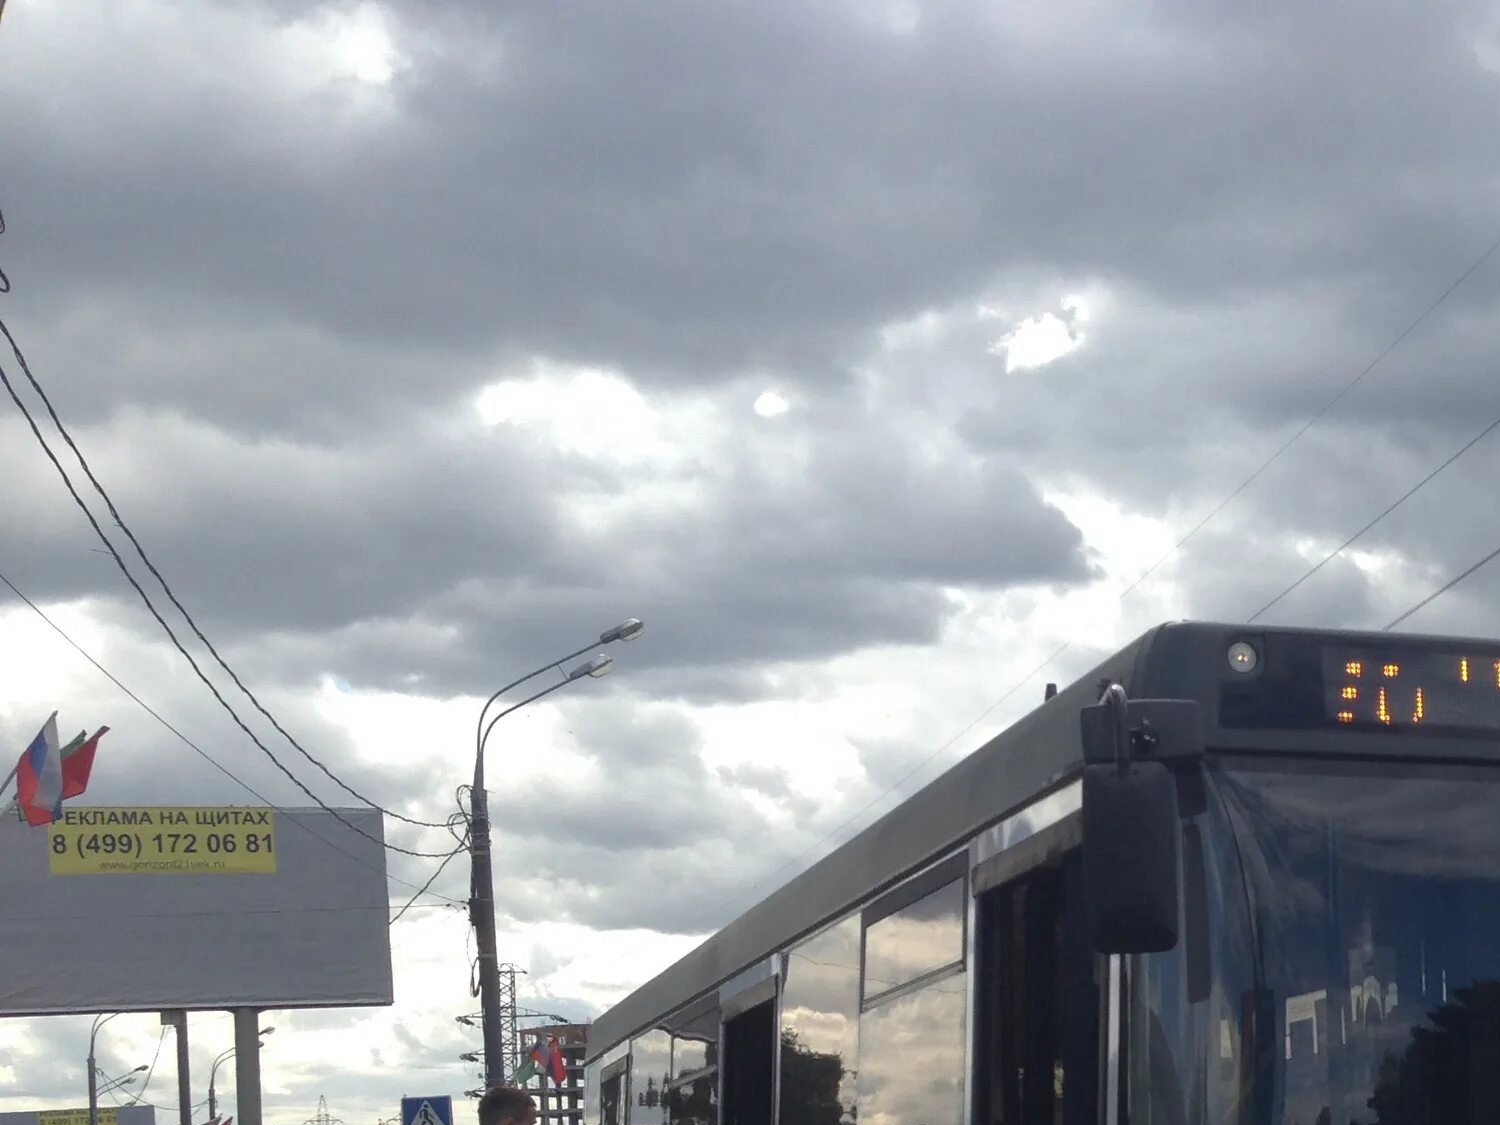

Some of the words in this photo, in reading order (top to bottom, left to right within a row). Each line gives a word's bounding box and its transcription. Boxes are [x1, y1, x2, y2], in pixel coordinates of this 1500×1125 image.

[159, 811, 188, 825] НА
[196, 811, 269, 827] ЩИТАХ
[52, 834, 67, 854] 8
[77, 833, 142, 858] (499)
[152, 834, 197, 853] 172
[207, 833, 237, 853] 06
[245, 833, 273, 853] 81
